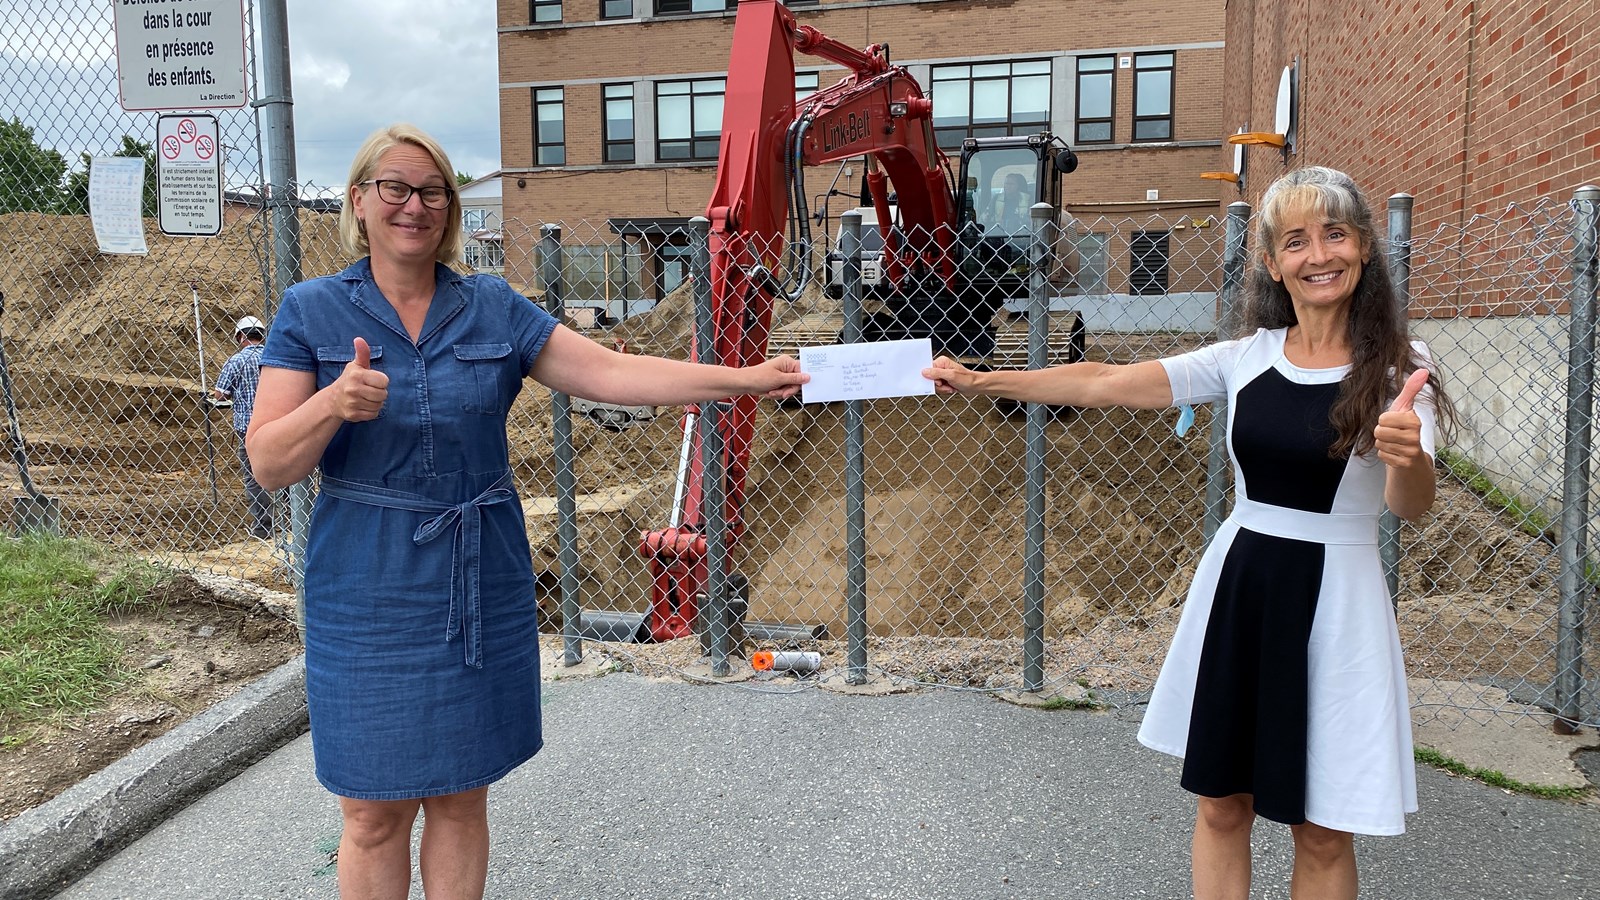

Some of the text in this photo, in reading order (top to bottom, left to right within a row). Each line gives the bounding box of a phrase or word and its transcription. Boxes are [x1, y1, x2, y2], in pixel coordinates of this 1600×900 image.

[143, 8, 212, 30] dans la cour
[146, 38, 214, 62] en présence
[148, 66, 216, 86] des enfants.
[822, 108, 871, 153] Link-Belt
